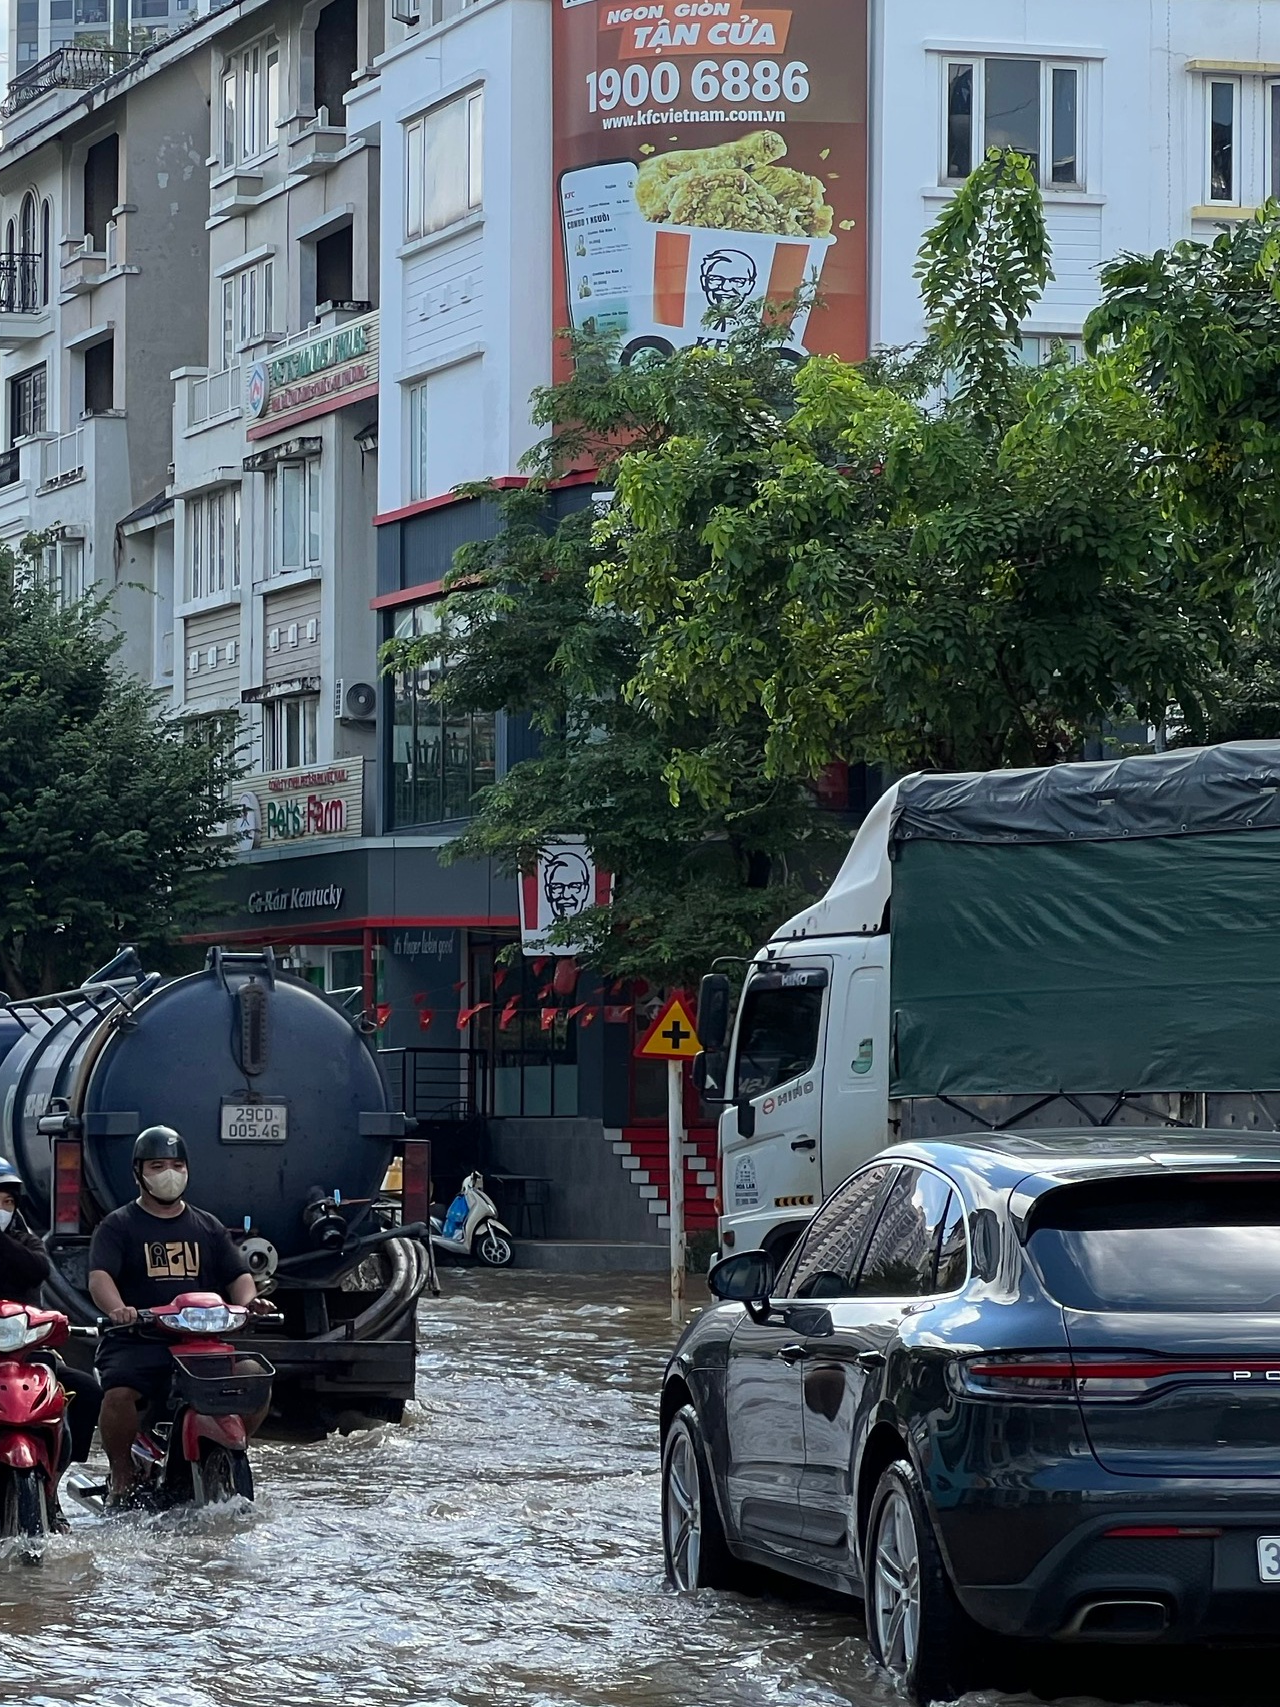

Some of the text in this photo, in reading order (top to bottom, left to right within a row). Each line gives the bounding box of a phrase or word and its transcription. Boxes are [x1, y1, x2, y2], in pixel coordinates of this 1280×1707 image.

[607, 5, 664, 25] NGON
[634, 15, 776, 54] TẬN CỬA
[586, 60, 810, 113] 1900 6886
[602, 108, 786, 130] www.kfcvietnam.com.vn
[267, 794, 346, 839] Pet's Farm
[290, 884, 342, 910] Kentucky
[781, 974, 809, 986] HINO
[777, 1080, 814, 1106] HINO
[236, 1108, 273, 1122] 29CD
[229, 1123, 280, 1138] 005.46
[144, 1241, 200, 1277] LAZY
[1233, 1371, 1280, 1381] PO
